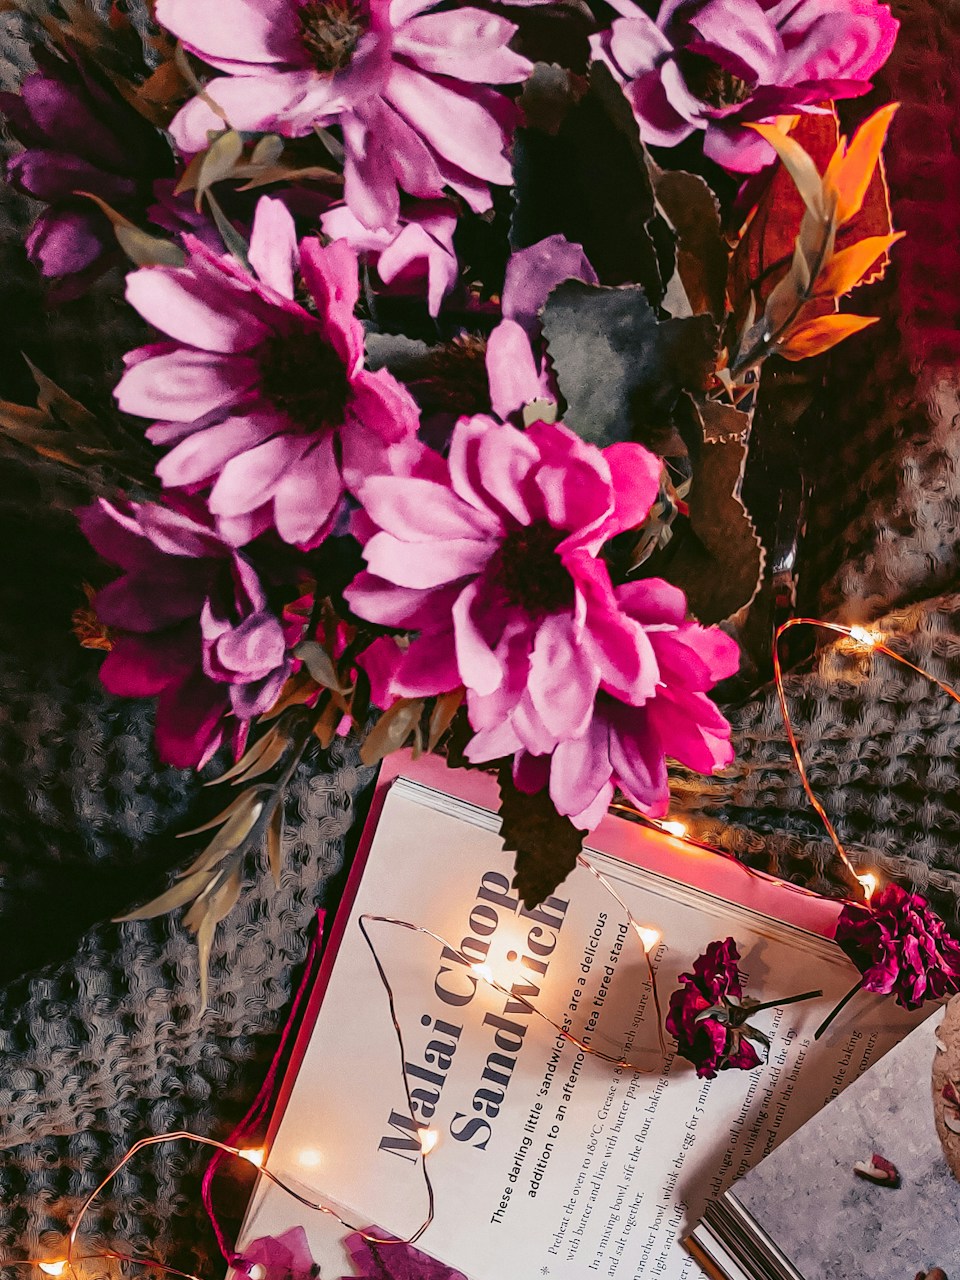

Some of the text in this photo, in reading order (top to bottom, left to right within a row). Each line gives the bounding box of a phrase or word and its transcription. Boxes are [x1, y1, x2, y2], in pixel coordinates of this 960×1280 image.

[606, 919, 631, 963] stand.
[591, 964, 616, 1007] tiered
[378, 869, 525, 1165] Malai Chop
[449, 894, 574, 1151] Sandwich
[583, 1009, 600, 1033] tea
[490, 1185, 514, 1225] These
[505, 1134, 533, 1184] darling
[523, 1100, 544, 1133] little
[567, 988, 583, 1011] are
[578, 911, 610, 973] delicious
[732, 1064, 765, 1126] buttermilk,
[546, 1123, 560, 1139] to
[547, 992, 652, 1255] Preheat the oven Grease square
[553, 1104, 567, 1121] an
[740, 1108, 768, 1157] whisking
[524, 1140, 554, 1198] addition
[597, 1076, 669, 1249] mixing bowl, flour, baking
[573, 1159, 609, 1236] butter line
[619, 1189, 646, 1236] together.
[633, 1131, 695, 1272] another whisk egg
